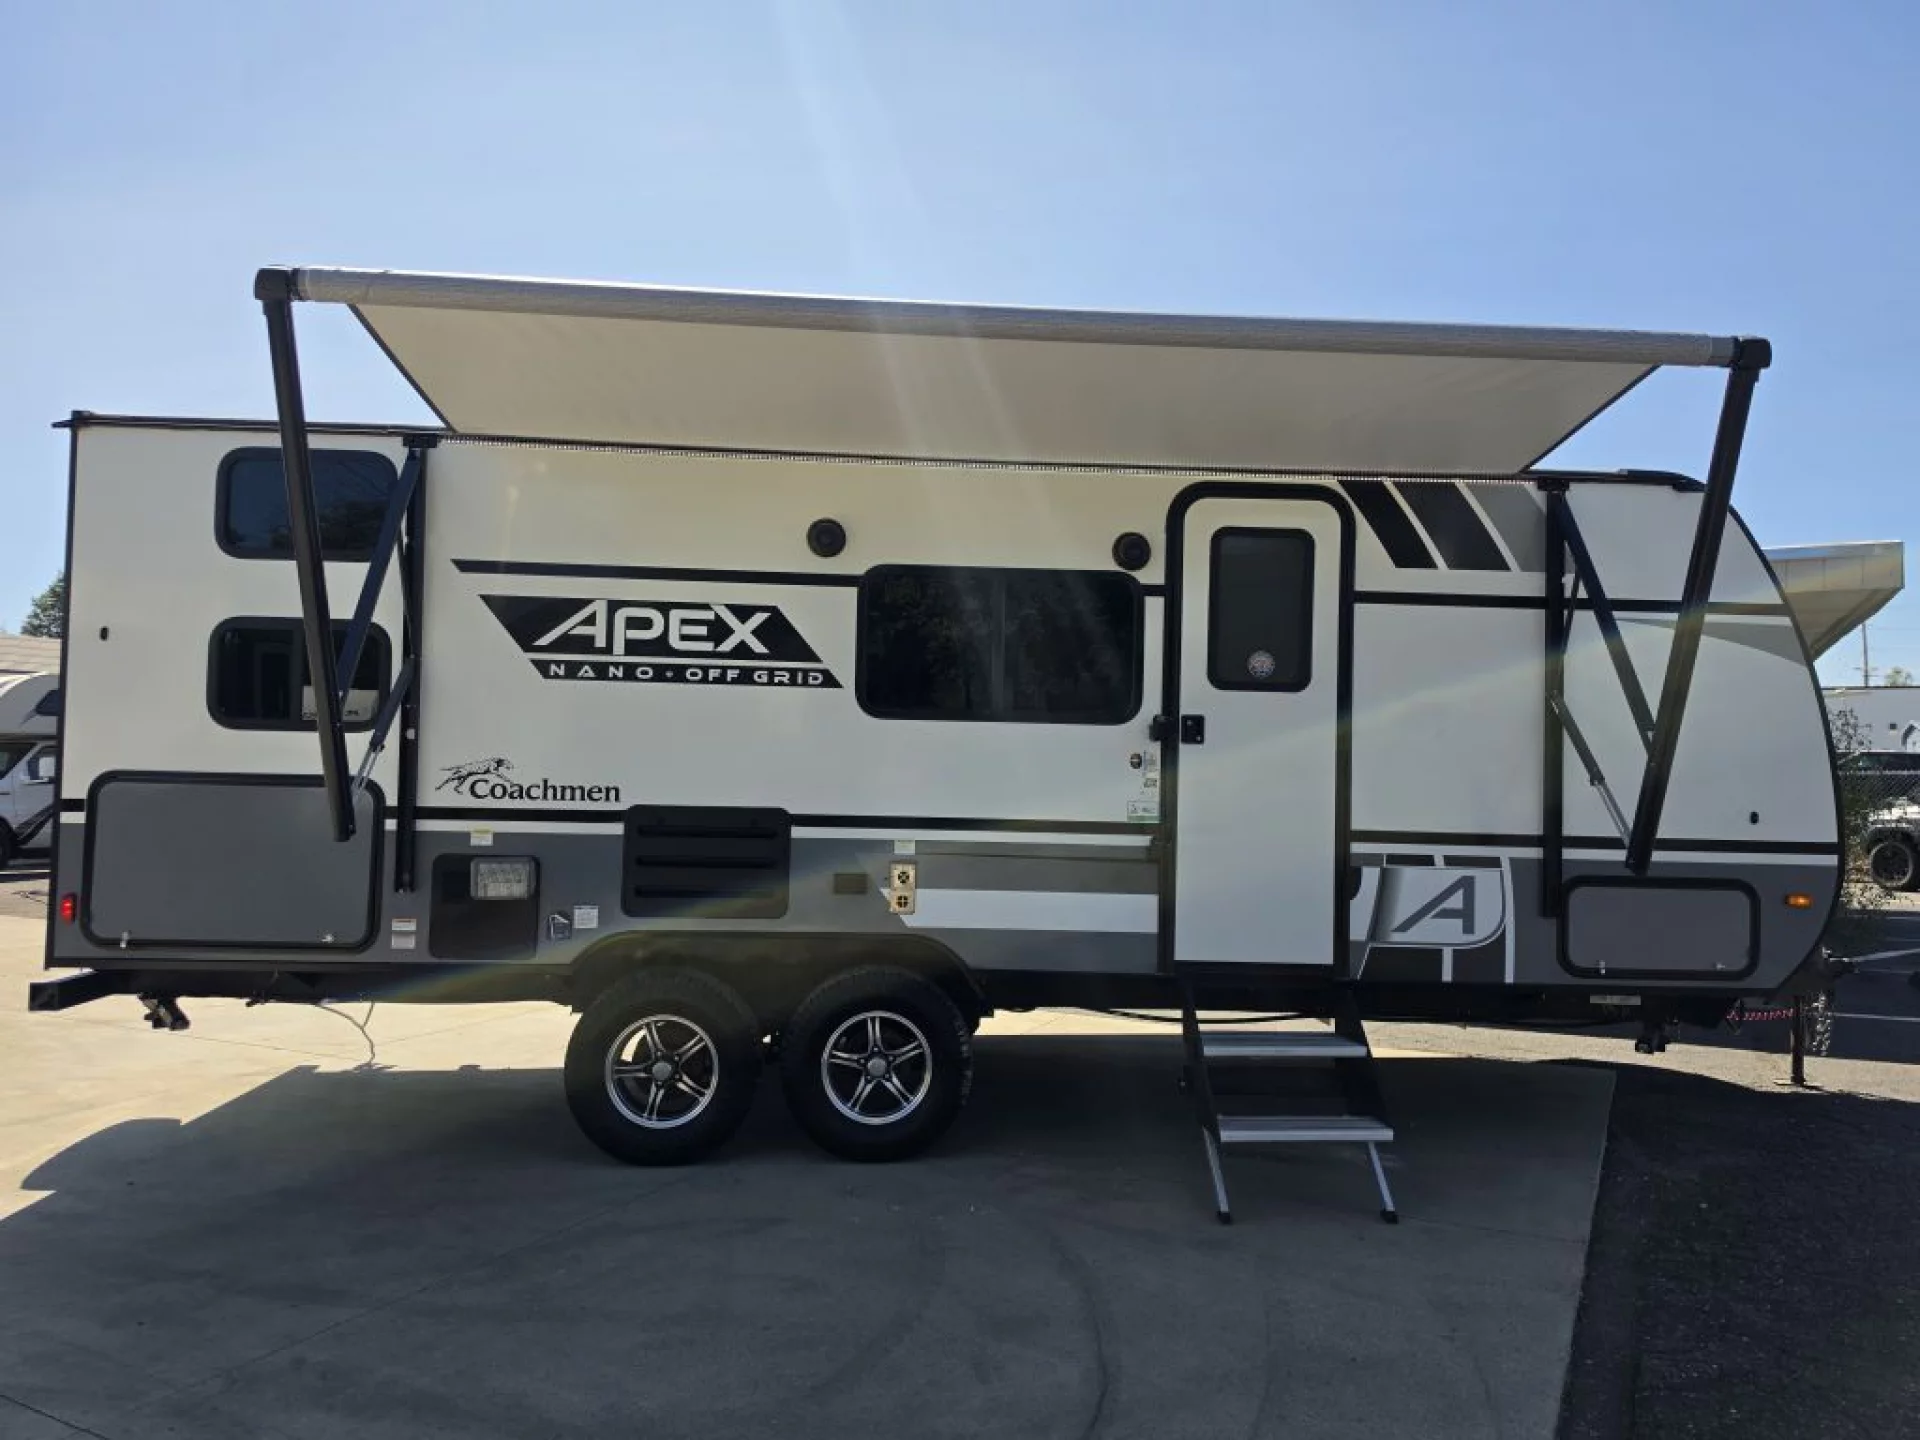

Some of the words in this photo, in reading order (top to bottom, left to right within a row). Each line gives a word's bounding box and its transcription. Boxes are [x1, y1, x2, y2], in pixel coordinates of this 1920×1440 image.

[532, 599, 772, 655] APEX
[549, 663, 654, 680] NANO
[685, 667, 740, 683] OFF
[753, 670, 824, 686] GRID
[469, 778, 621, 803] Coachmen
[1391, 875, 1475, 935] A
